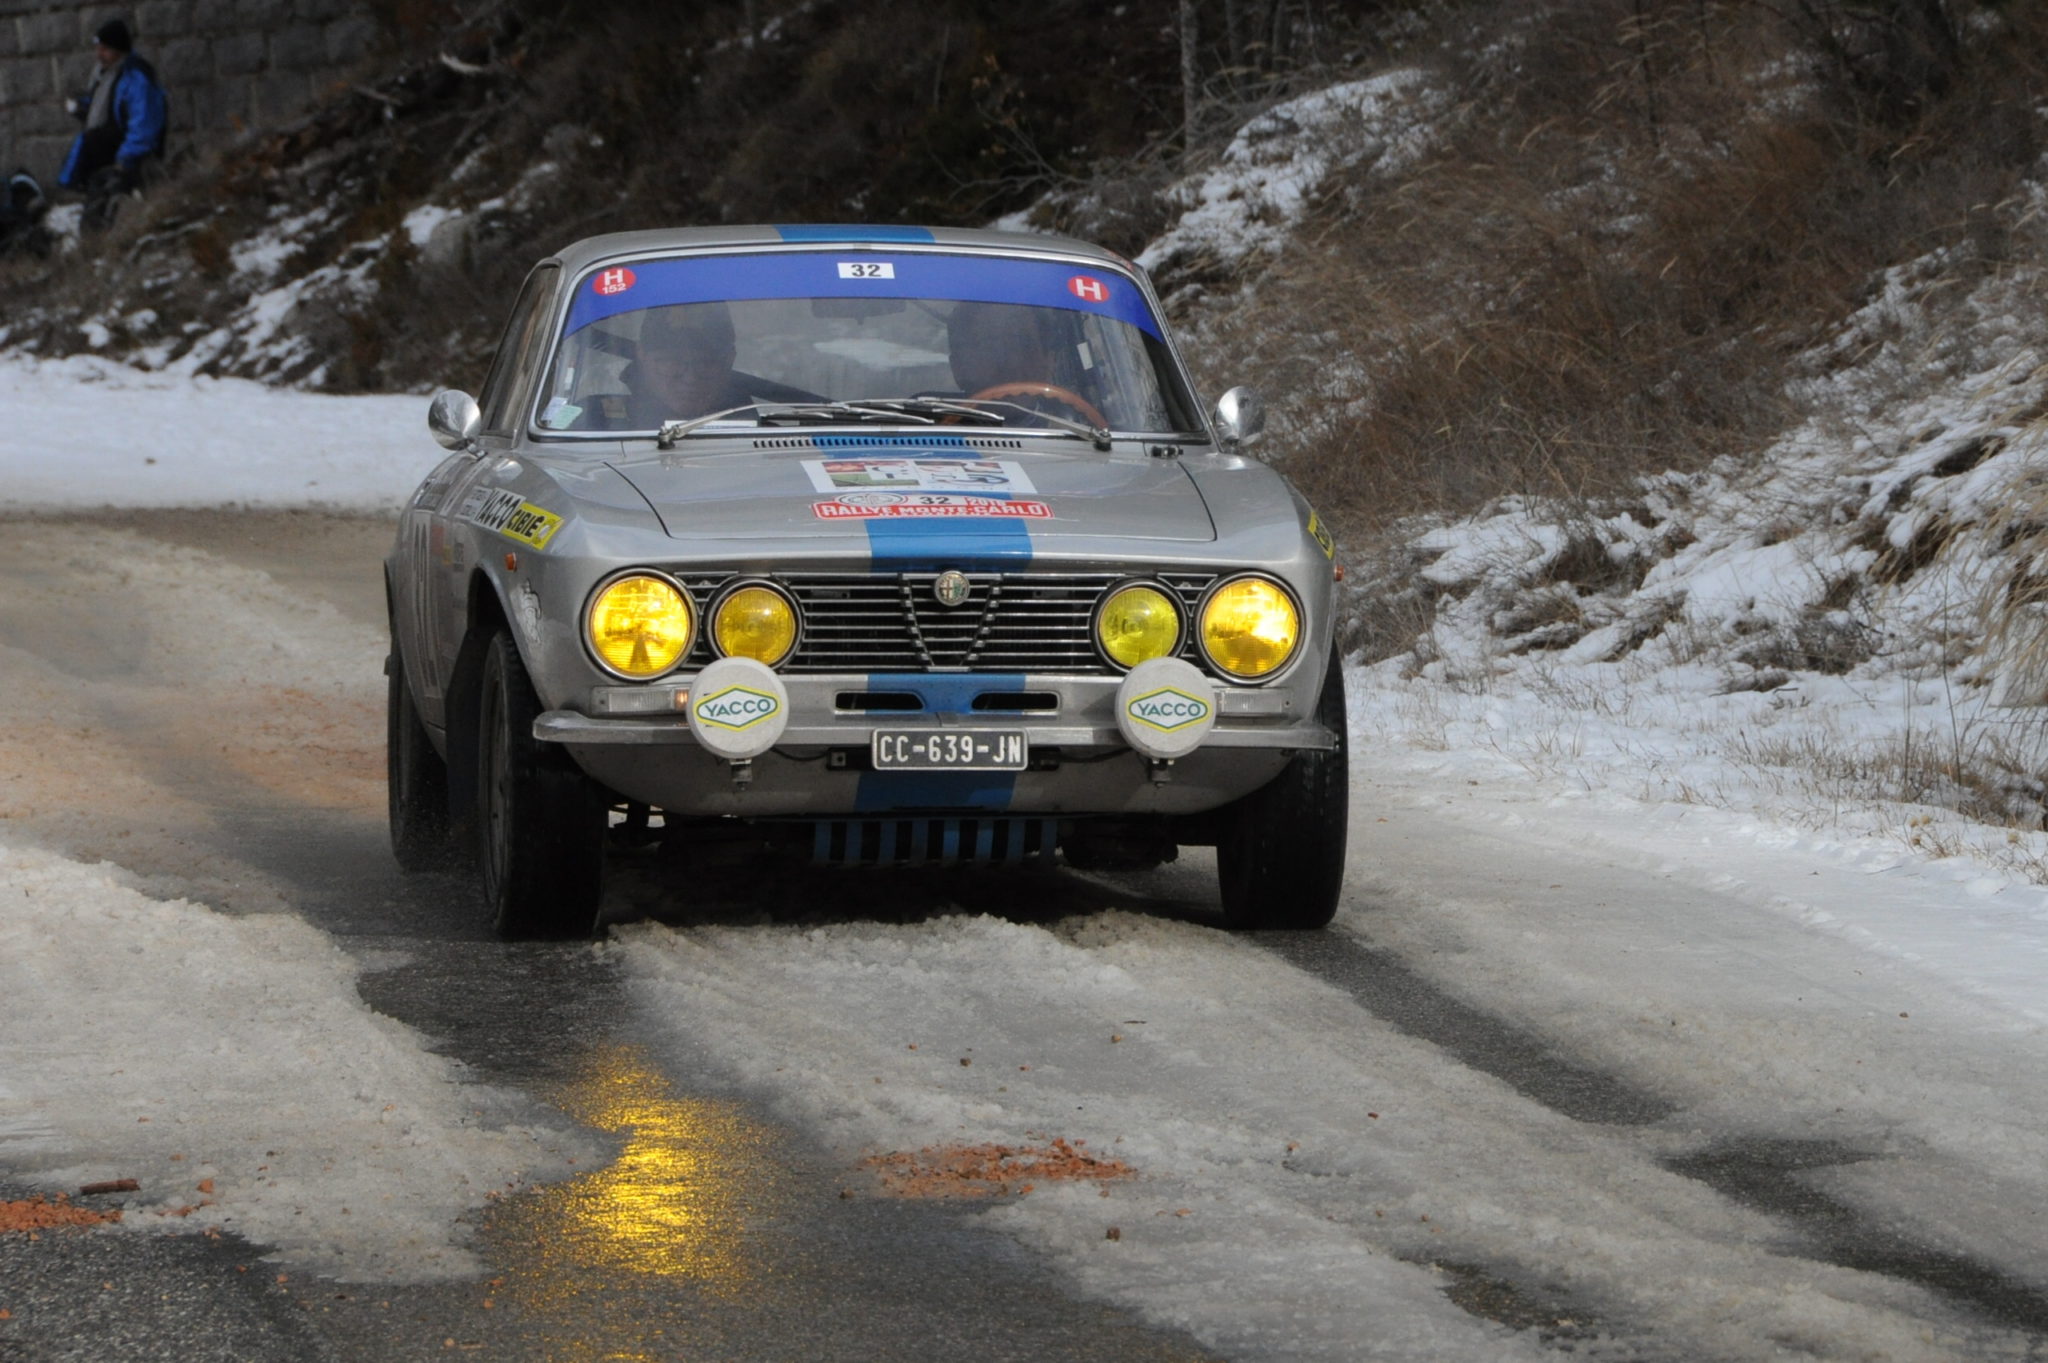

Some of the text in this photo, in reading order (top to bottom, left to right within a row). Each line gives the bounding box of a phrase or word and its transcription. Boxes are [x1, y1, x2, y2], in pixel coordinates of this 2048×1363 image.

[604, 269, 623, 285] H
[851, 264, 882, 277] 32
[602, 283, 627, 294] 152
[1075, 278, 1102, 300] H
[919, 496, 952, 504] 32
[474, 490, 520, 530] YACCO
[821, 505, 893, 516] RALLYE
[898, 505, 1044, 516] MONTE-CARLO
[705, 699, 771, 717] YACCO
[1138, 703, 1201, 716] YACCO
[880, 735, 1021, 763] CC-639-JN
